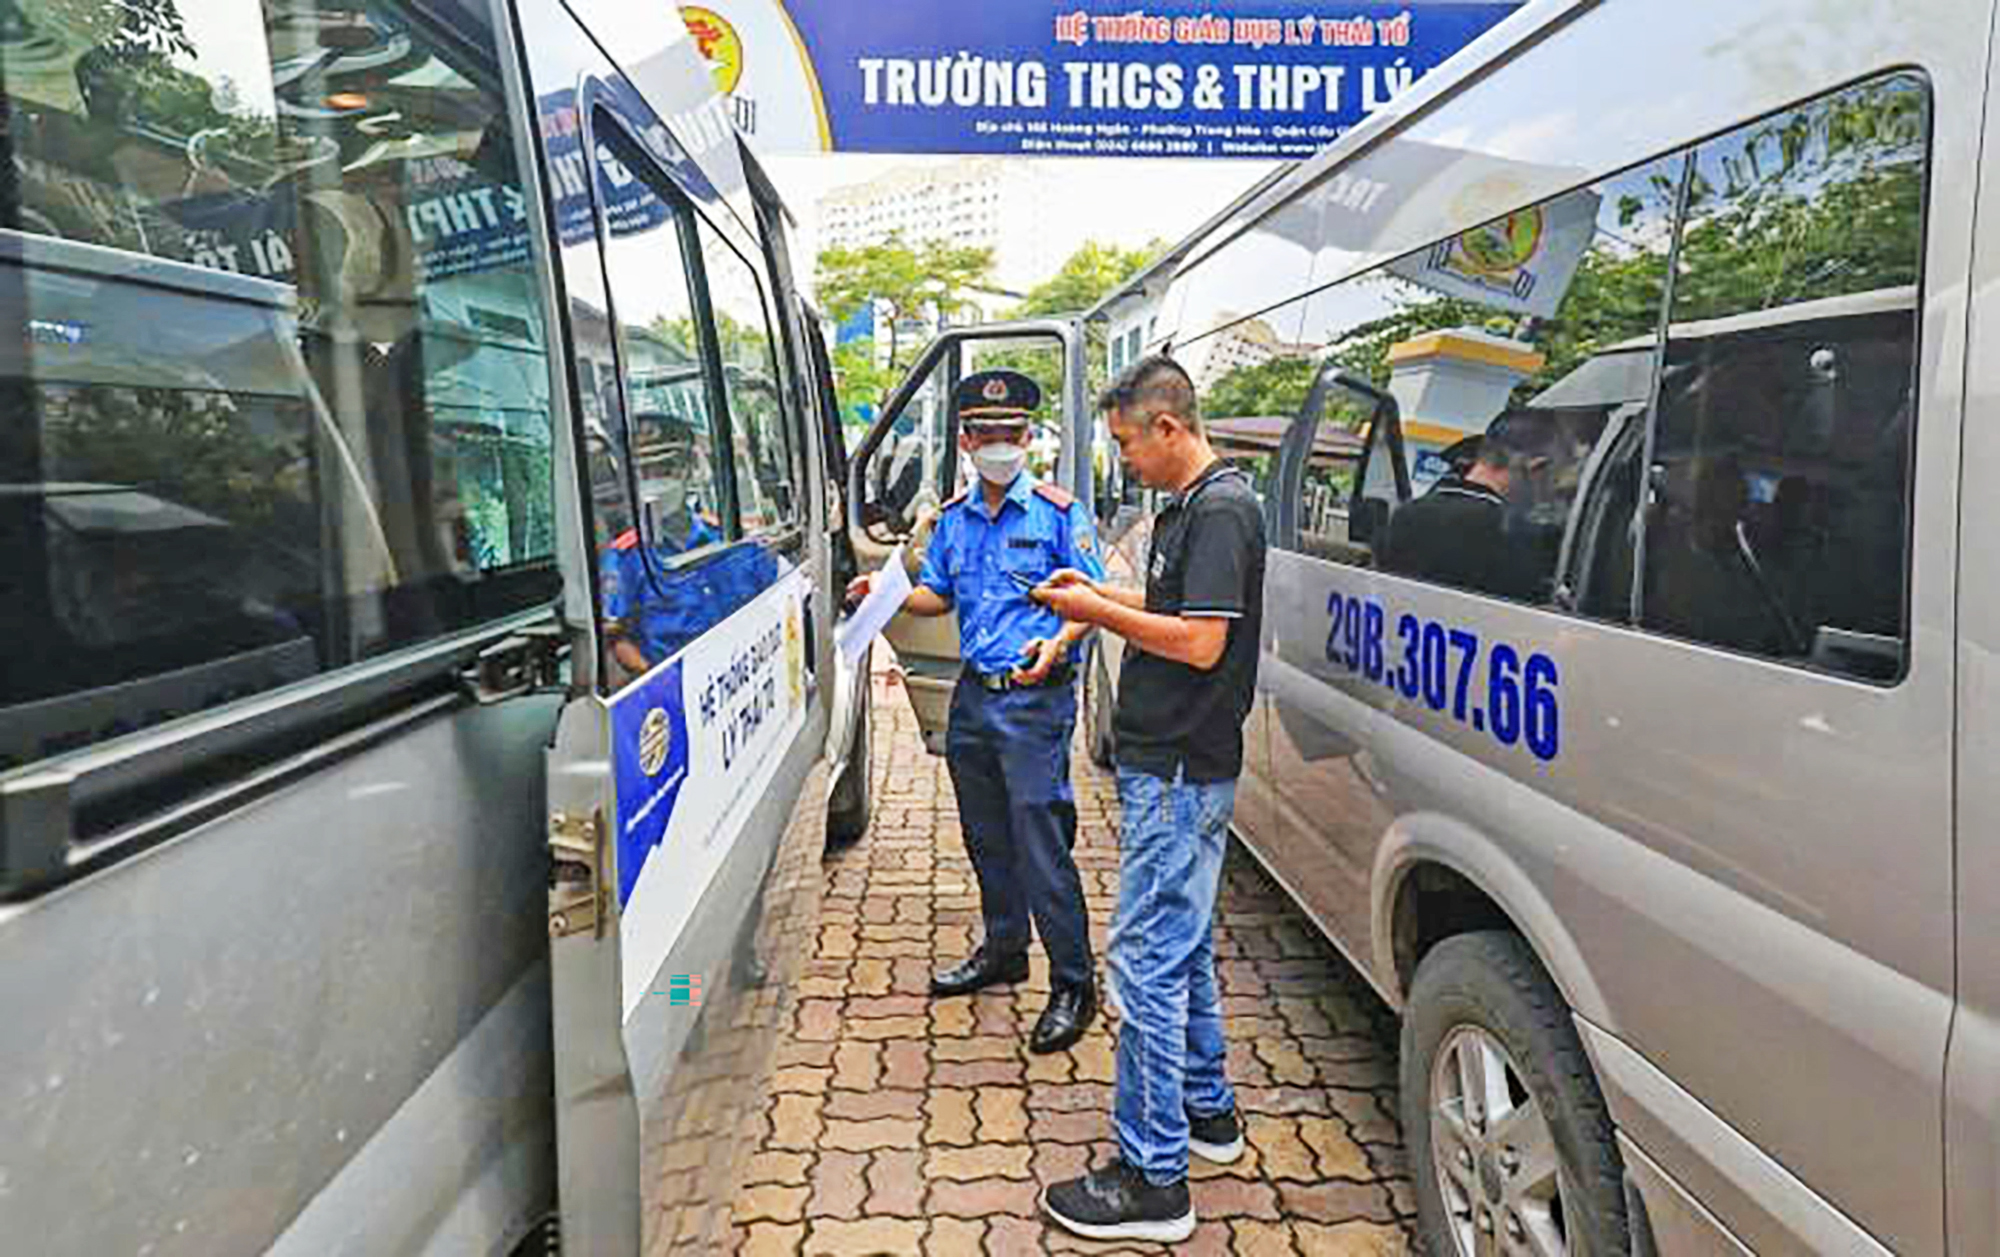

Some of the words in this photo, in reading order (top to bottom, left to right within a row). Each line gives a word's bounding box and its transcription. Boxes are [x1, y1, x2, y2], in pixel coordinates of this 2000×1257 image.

[1054, 11, 1088, 46] HỆ
[1284, 12, 1316, 44] LÝ
[858, 50, 1047, 107] TRƯỜNG
[1063, 61, 1184, 110] THCS
[1192, 63, 1225, 111] &
[1233, 64, 1345, 112] THPT
[1361, 57, 1413, 112] LÝ
[1326, 591, 1559, 762] 29B.307.66
